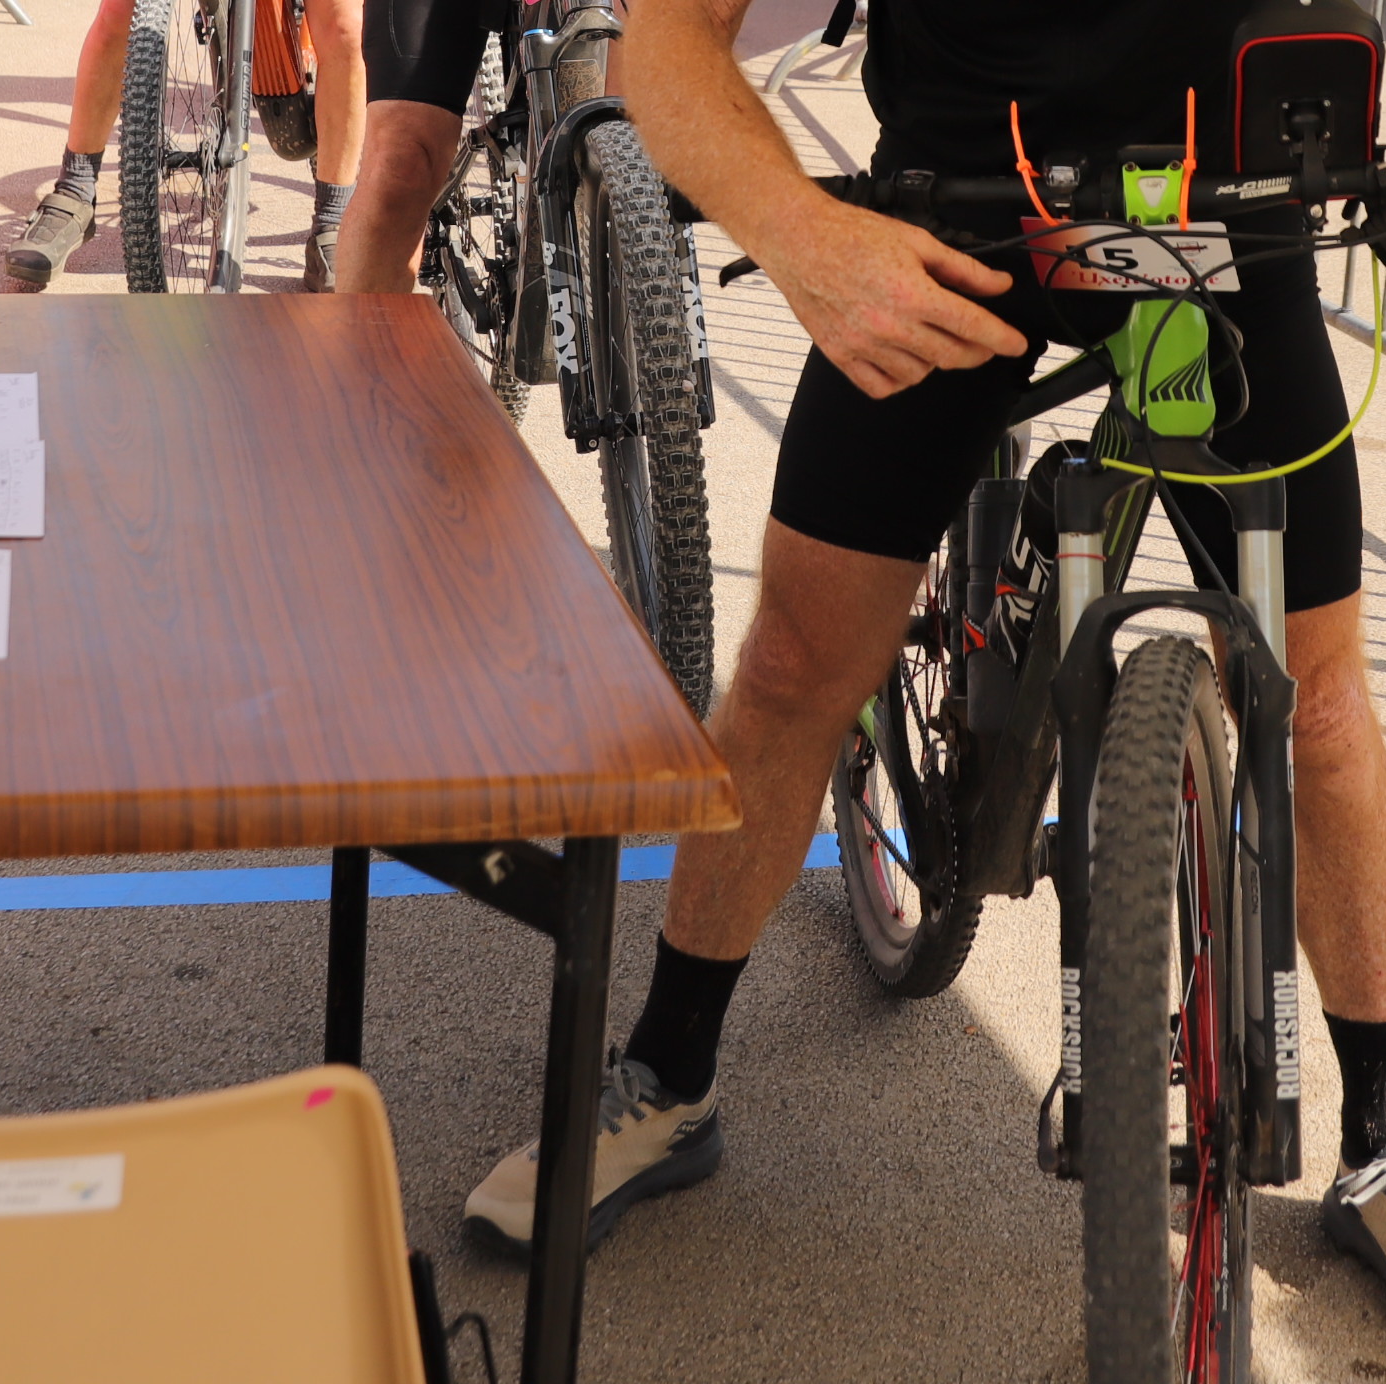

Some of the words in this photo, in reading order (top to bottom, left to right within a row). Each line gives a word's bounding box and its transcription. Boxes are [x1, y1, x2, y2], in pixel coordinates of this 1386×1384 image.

[1065, 243, 1140, 271] 15
[548, 287, 580, 374] FOX
[681, 274, 711, 362] FOX
[1061, 967, 1082, 1094] ROCKSHOX
[1273, 970, 1301, 1101] ROCKSHOX
